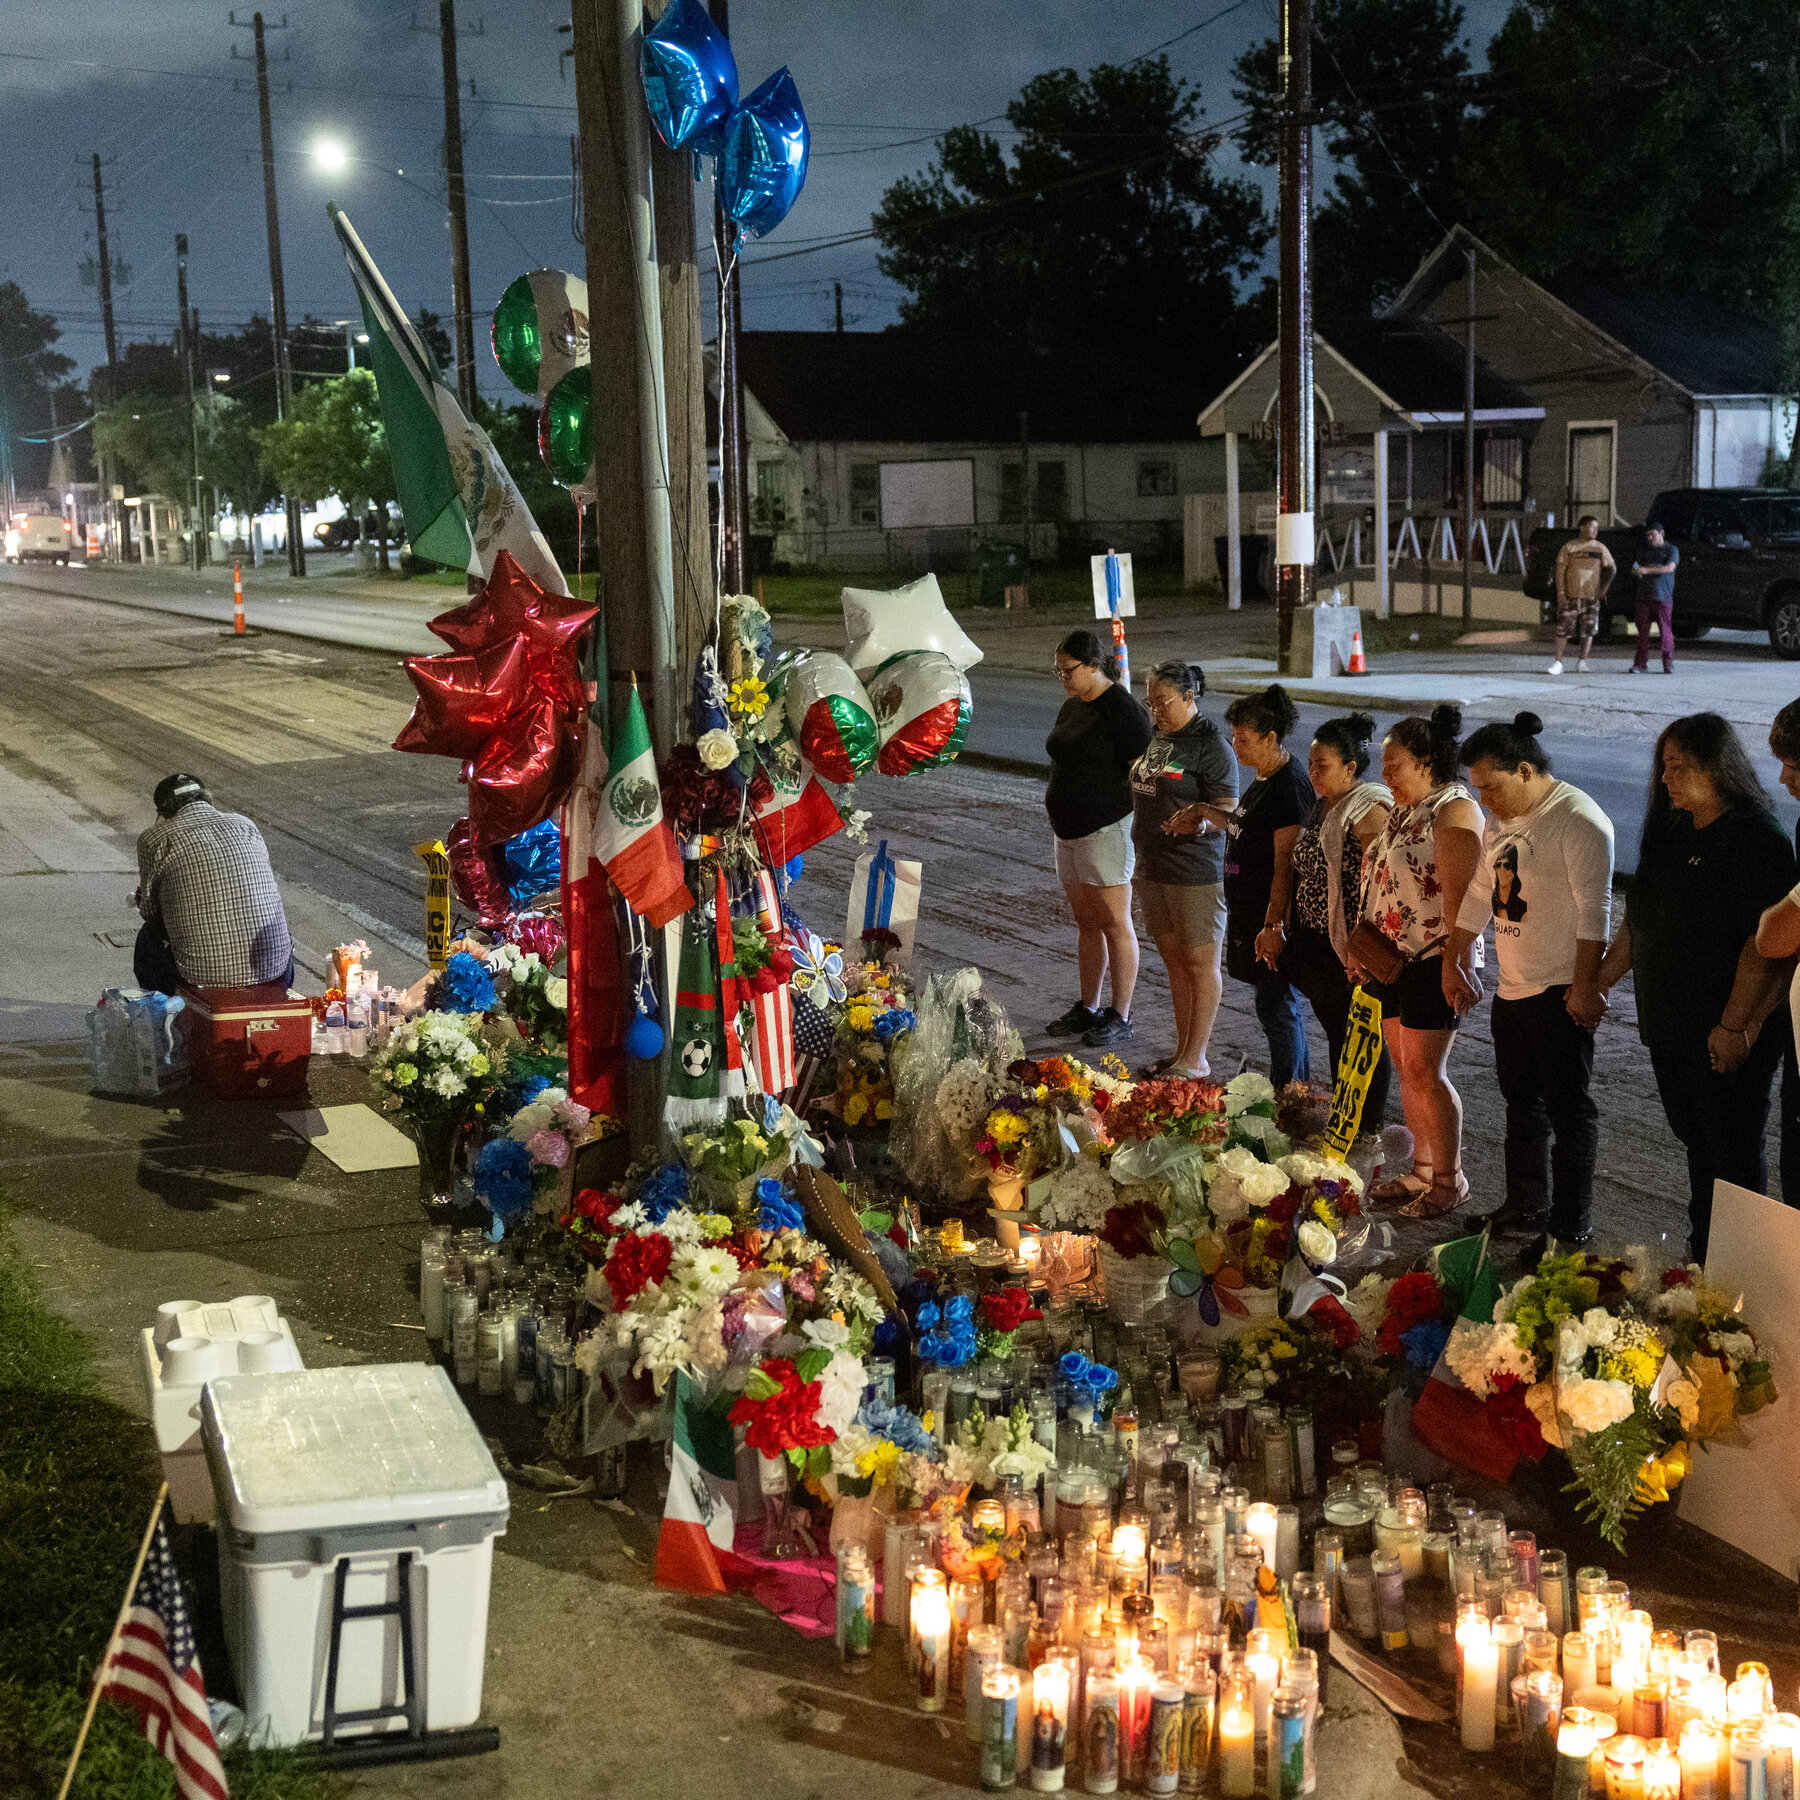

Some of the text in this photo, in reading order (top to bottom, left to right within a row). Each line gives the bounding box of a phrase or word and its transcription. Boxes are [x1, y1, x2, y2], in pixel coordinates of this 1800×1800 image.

[1250, 421, 1344, 440] INSCE
[1132, 782, 1155, 794] MEXICO
[1495, 922, 1521, 938] GUAPO
